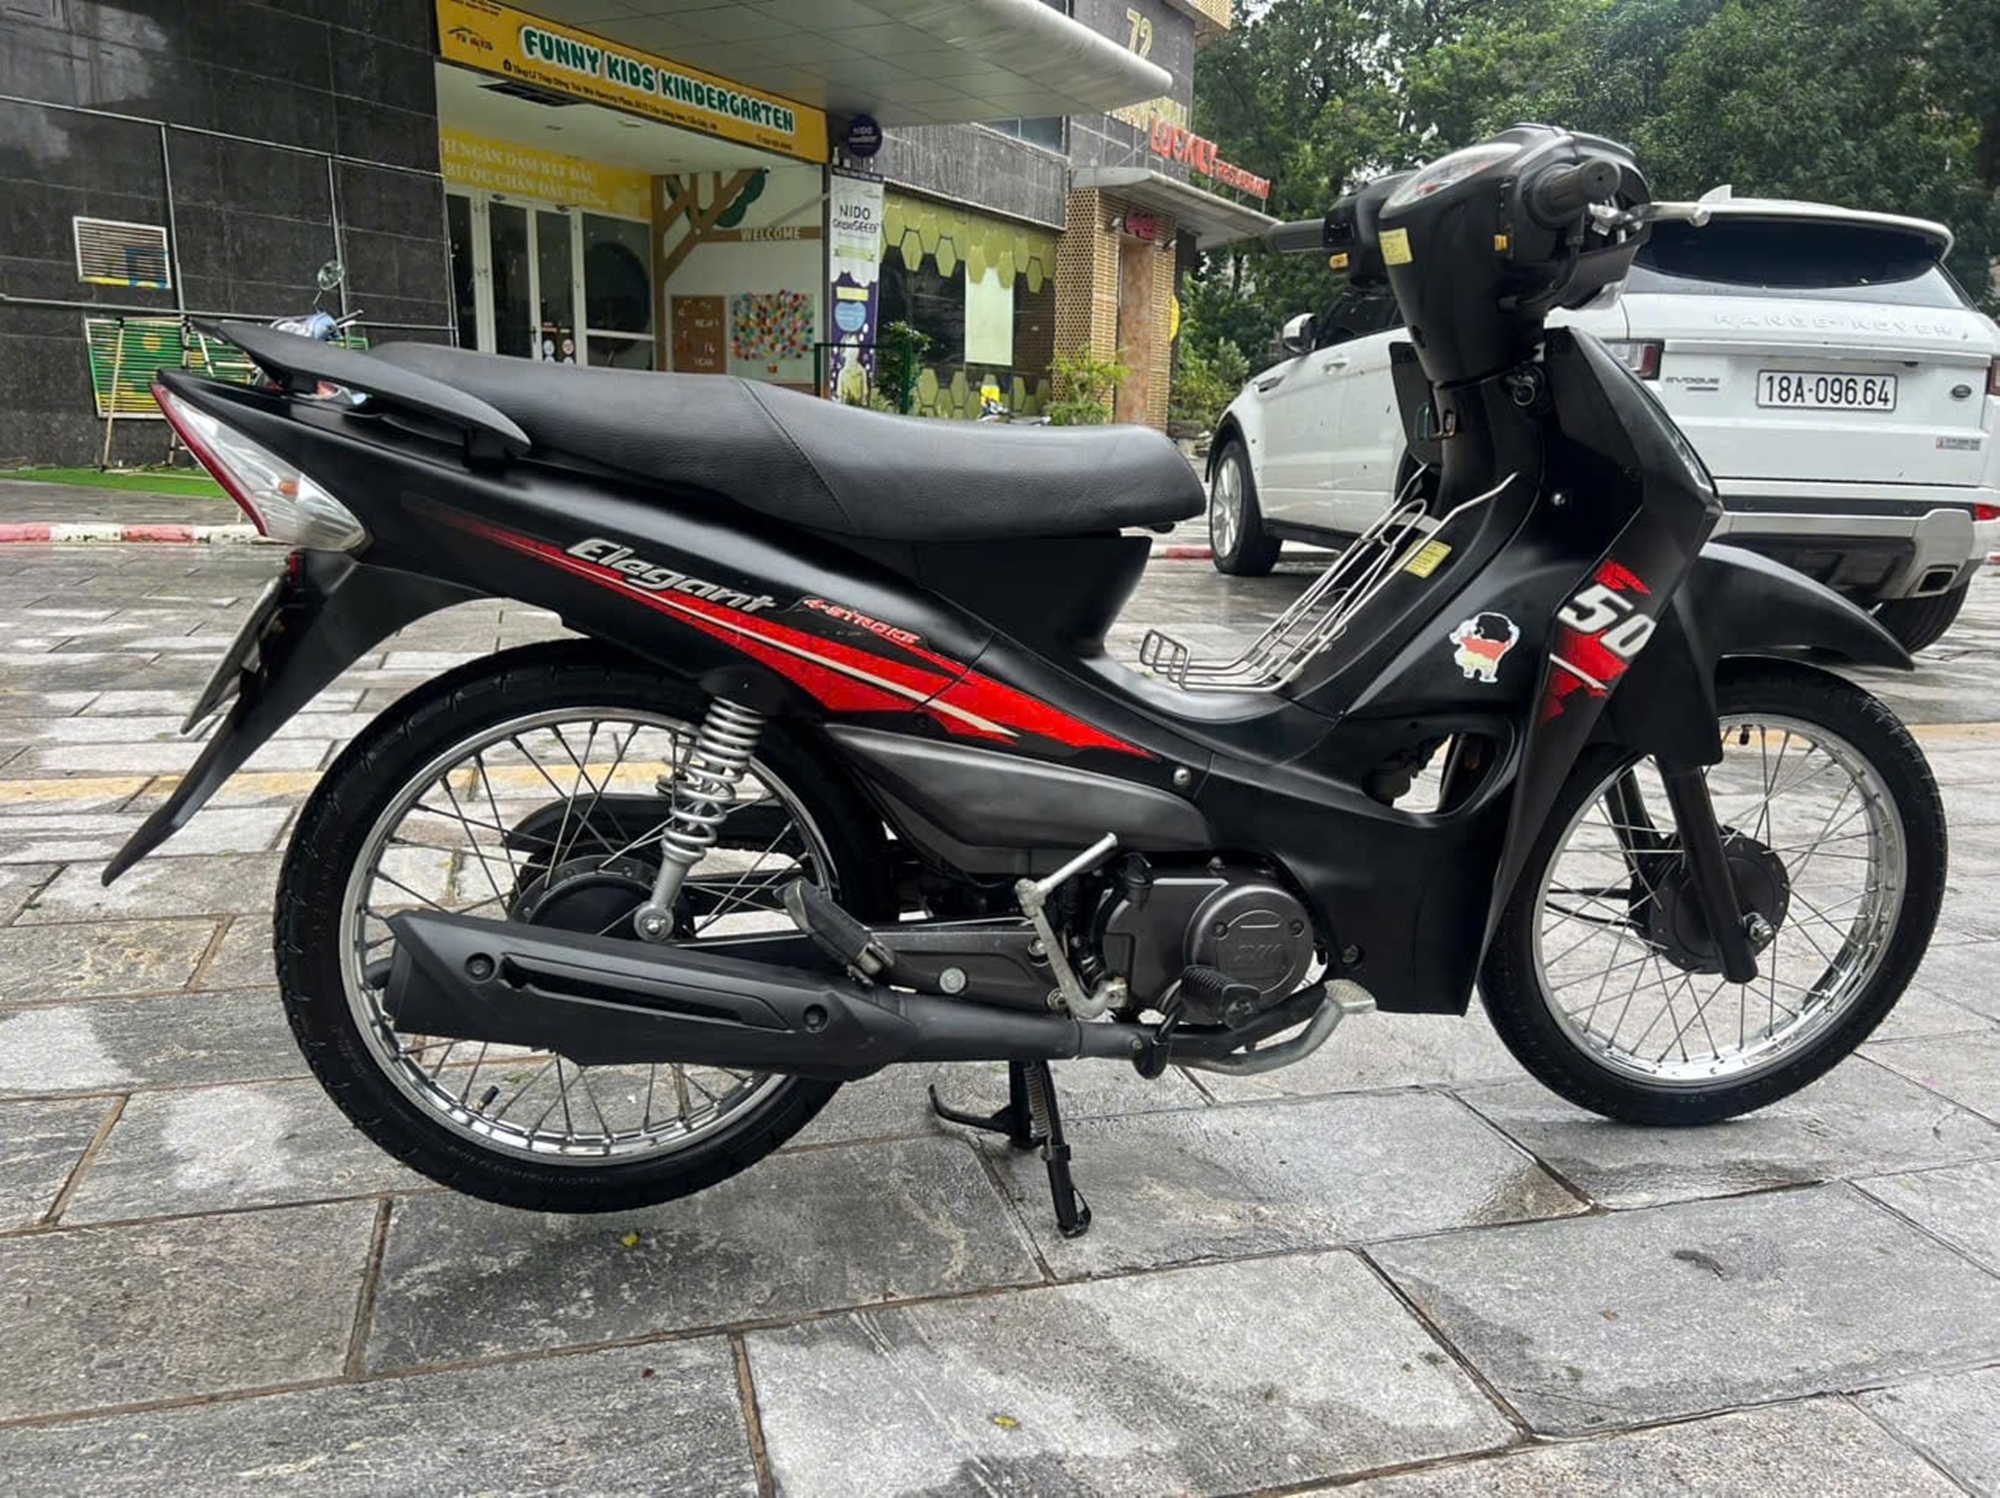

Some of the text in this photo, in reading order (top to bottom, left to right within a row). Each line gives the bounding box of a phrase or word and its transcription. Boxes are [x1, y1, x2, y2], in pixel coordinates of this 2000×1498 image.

[521, 26, 602, 76] FUNNY
[606, 52, 656, 93] KIDS
[660, 70, 796, 134] KINDERGARTEN
[741, 226, 801, 241] WELCOME
[839, 204, 871, 221] NIDO
[1715, 314, 1951, 337] RANGE ROVER
[566, 538, 777, 613] Elegant
[1557, 584, 1656, 657] 50
